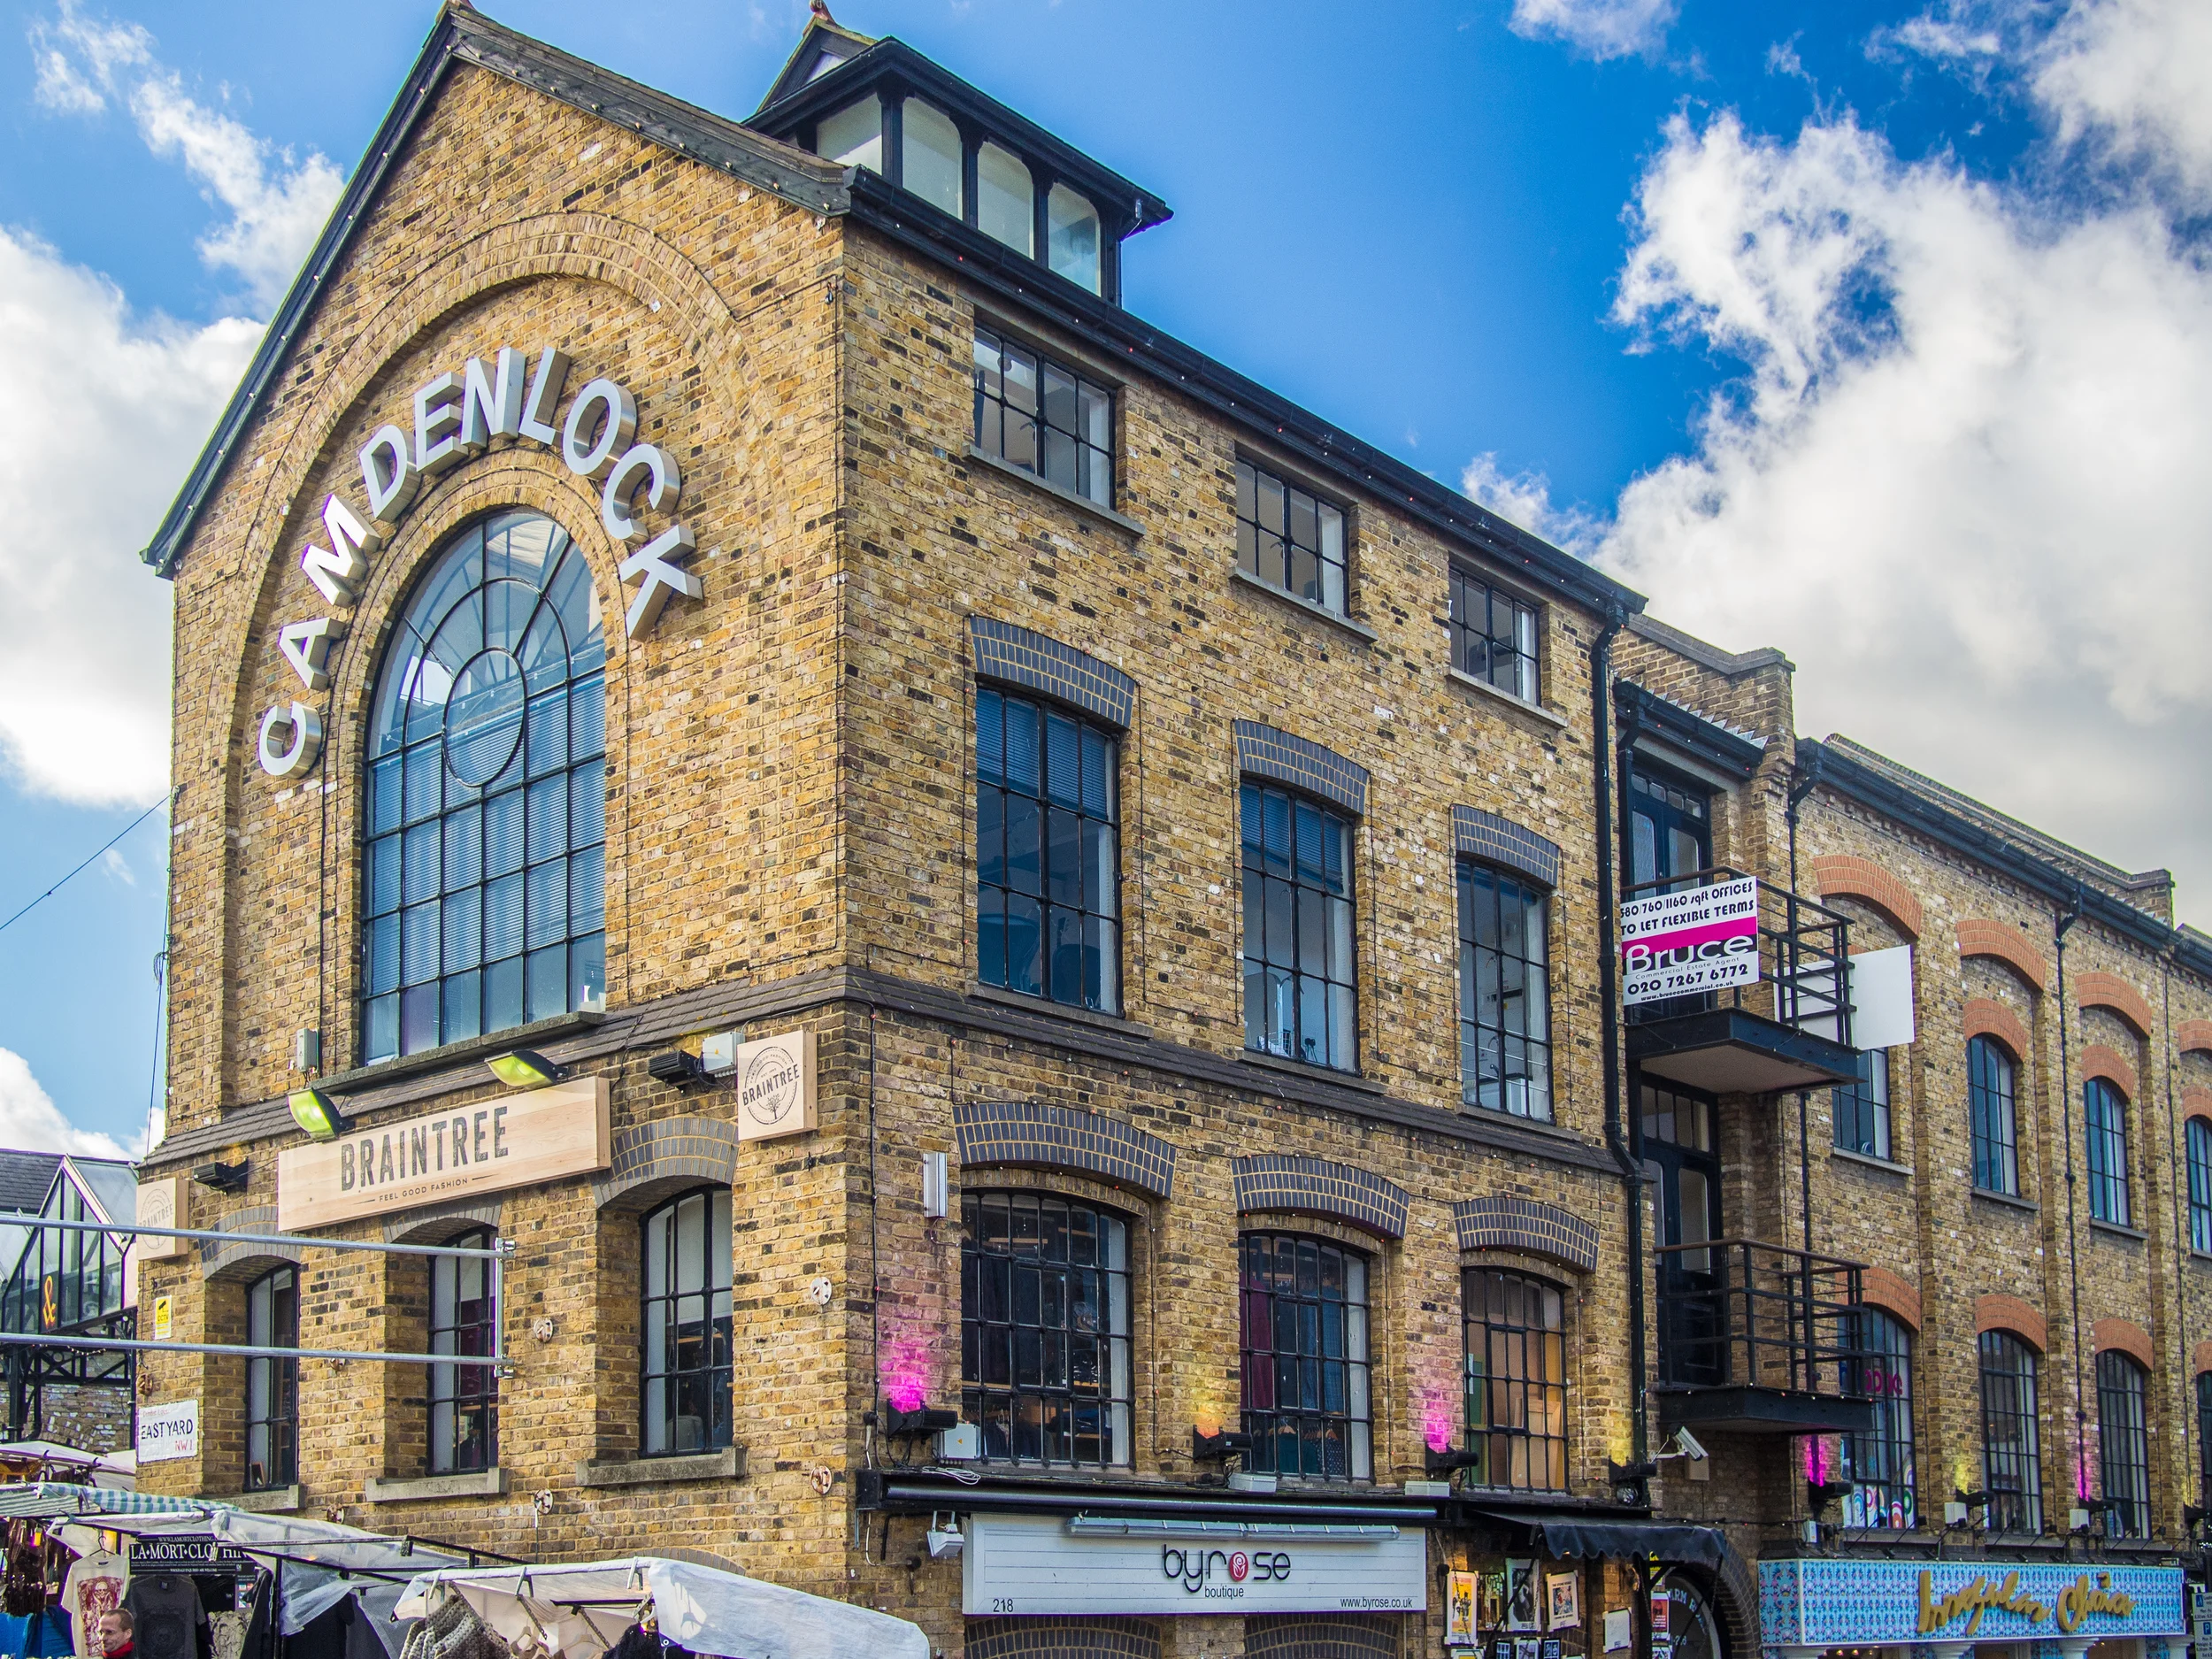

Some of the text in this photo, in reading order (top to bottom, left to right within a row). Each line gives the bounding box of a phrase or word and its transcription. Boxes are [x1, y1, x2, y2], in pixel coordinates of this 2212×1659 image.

[1690, 891, 1709, 906] sqft
[1711, 881, 1753, 899] OFFICES
[1621, 900, 1754, 935] TO LET FLEXIBLE TERMS
[1625, 935, 1754, 975] Bruce
[1627, 964, 1748, 995] 020 7267 6772
[1635, 956, 1740, 979] Commercial Estate Agent
[1640, 981, 1734, 1002] www.brucecommercial.co.uk
[741, 1064, 800, 1106] BRAINTREE
[341, 1106, 509, 1191] BRAINTREE
[379, 1178, 468, 1202] FEEL GOOD FASHION
[142, 1418, 193, 1440] EAST YARD
[175, 1440, 188, 1451] NW
[1162, 1543, 1292, 1593] byrose
[1204, 1585, 1244, 1600] boutique
[1340, 1596, 1413, 1610] www.byrose.co.uk
[992, 1598, 1014, 1613] 218
